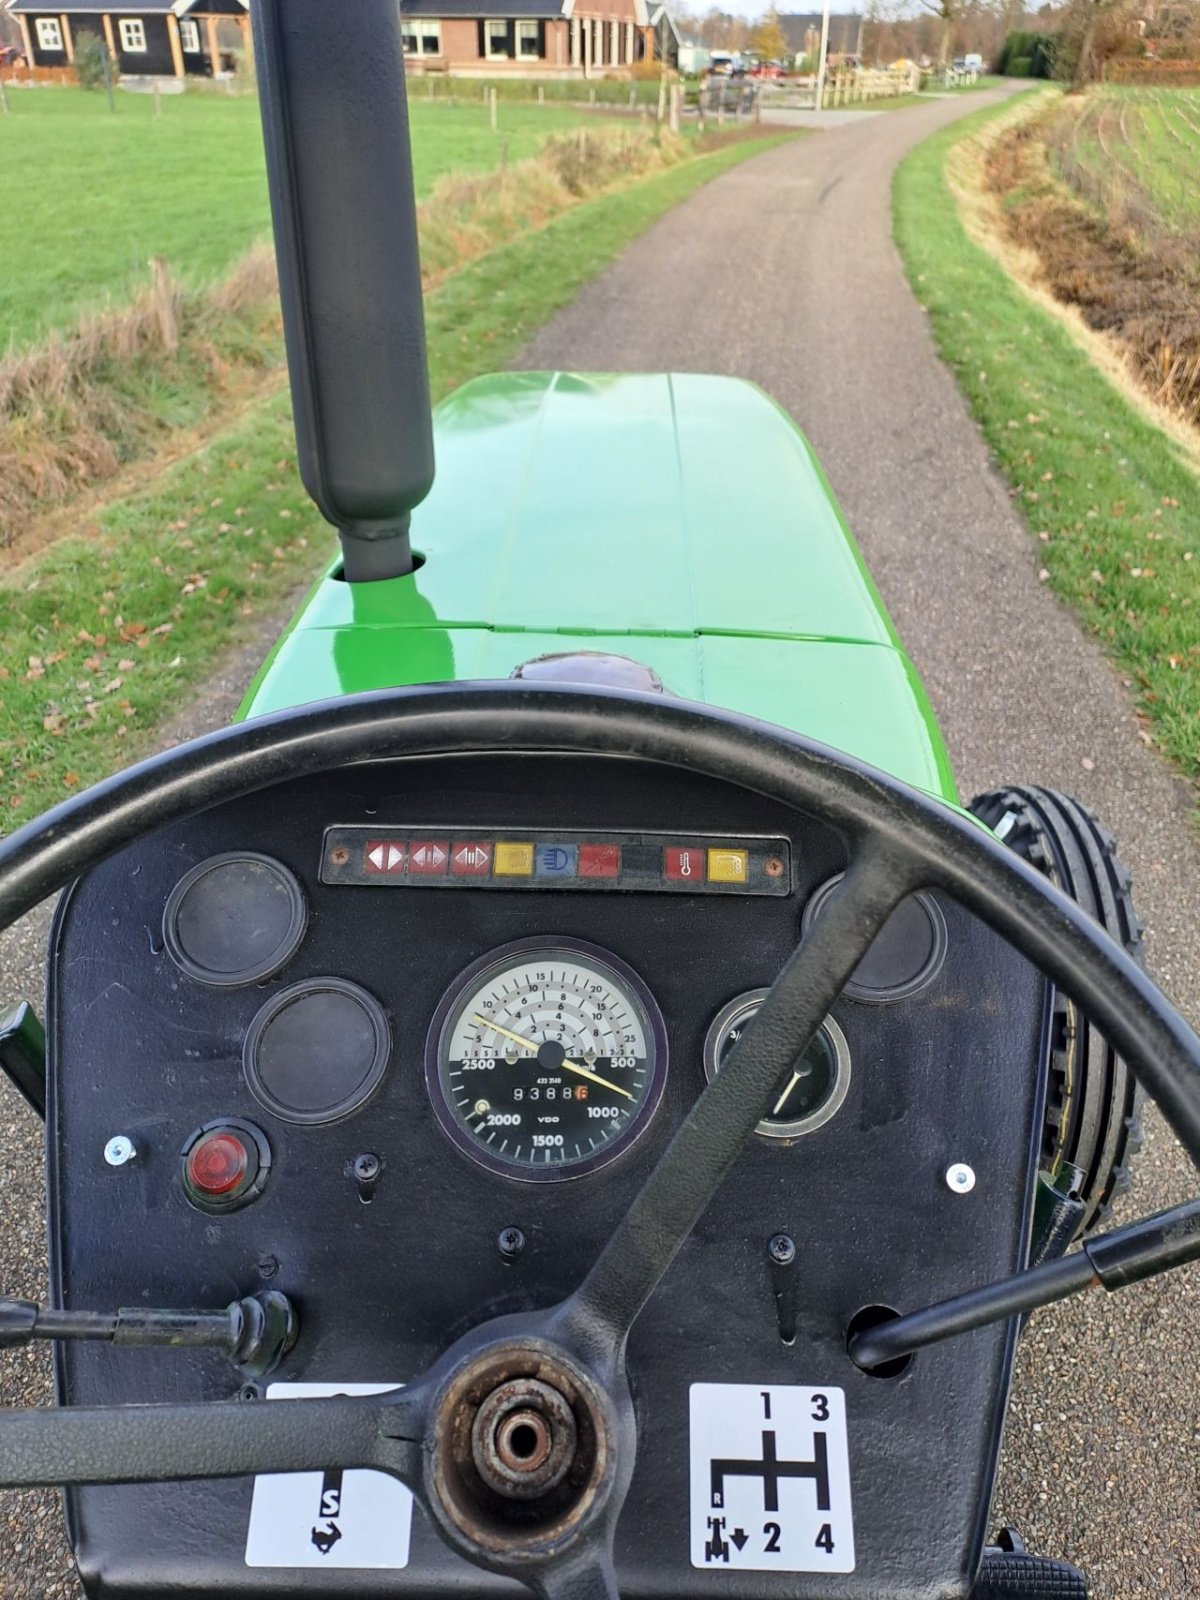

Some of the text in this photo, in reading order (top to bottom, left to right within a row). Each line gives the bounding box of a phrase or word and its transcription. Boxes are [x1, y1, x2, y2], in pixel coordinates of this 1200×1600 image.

[597, 1002, 606, 1010] 15
[515, 1012, 522, 1020] 4
[556, 1033, 563, 1041] 2
[592, 1028, 599, 1036] 8
[476, 1034, 482, 1043] 5
[624, 1034, 636, 1042] 25
[462, 1059, 496, 1070] 2500
[610, 1057, 636, 1068] 500
[587, 1107, 619, 1118] 1000
[486, 1114, 522, 1126] 2000
[532, 1134, 564, 1147] 1500
[760, 1392, 830, 1422] 1 3
[322, 1489, 340, 1515] S
[714, 1492, 722, 1504] R
[763, 1522, 834, 1554] 2 4
